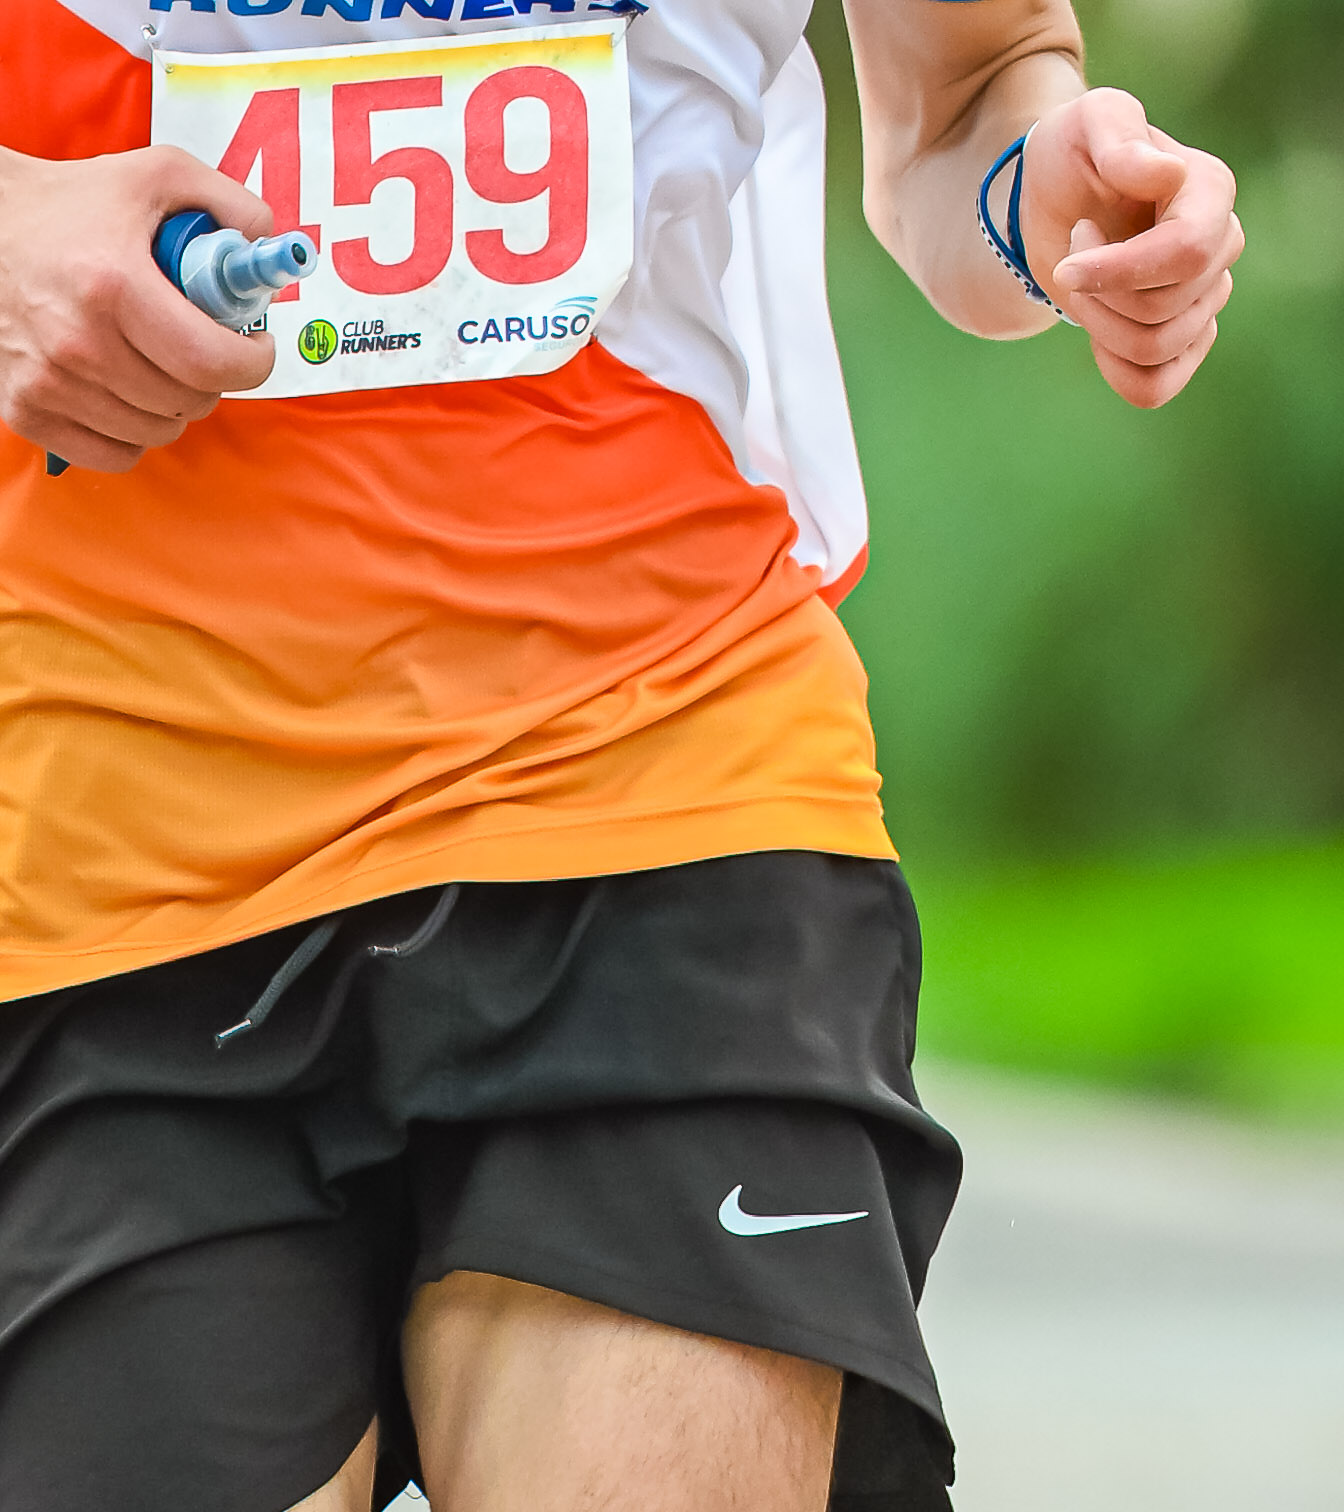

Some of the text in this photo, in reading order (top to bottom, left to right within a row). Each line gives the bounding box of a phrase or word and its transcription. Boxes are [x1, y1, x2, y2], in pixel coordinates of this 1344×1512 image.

[216, 65, 589, 302] 459
[342, 319, 384, 337] CLUB
[457, 313, 591, 345] CARUSO
[340, 332, 422, 355] RUNNER'S
